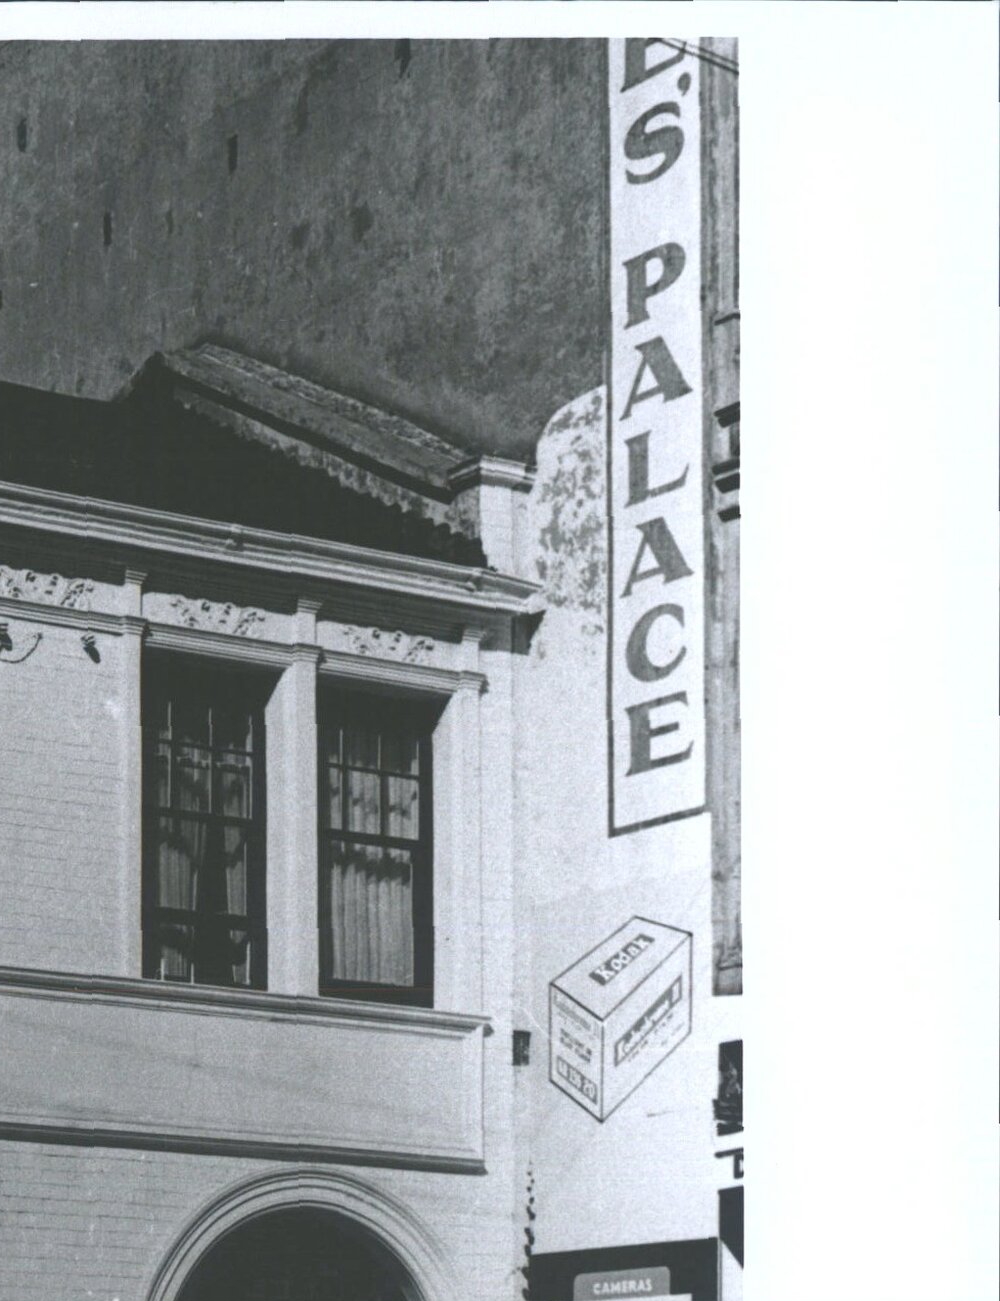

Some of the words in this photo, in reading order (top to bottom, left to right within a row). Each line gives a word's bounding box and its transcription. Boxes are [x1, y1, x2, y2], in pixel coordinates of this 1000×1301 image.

[619, 242, 693, 775] PALACE
[593, 934, 653, 984] Kodak
[593, 1278, 653, 1295] CAMERAS
